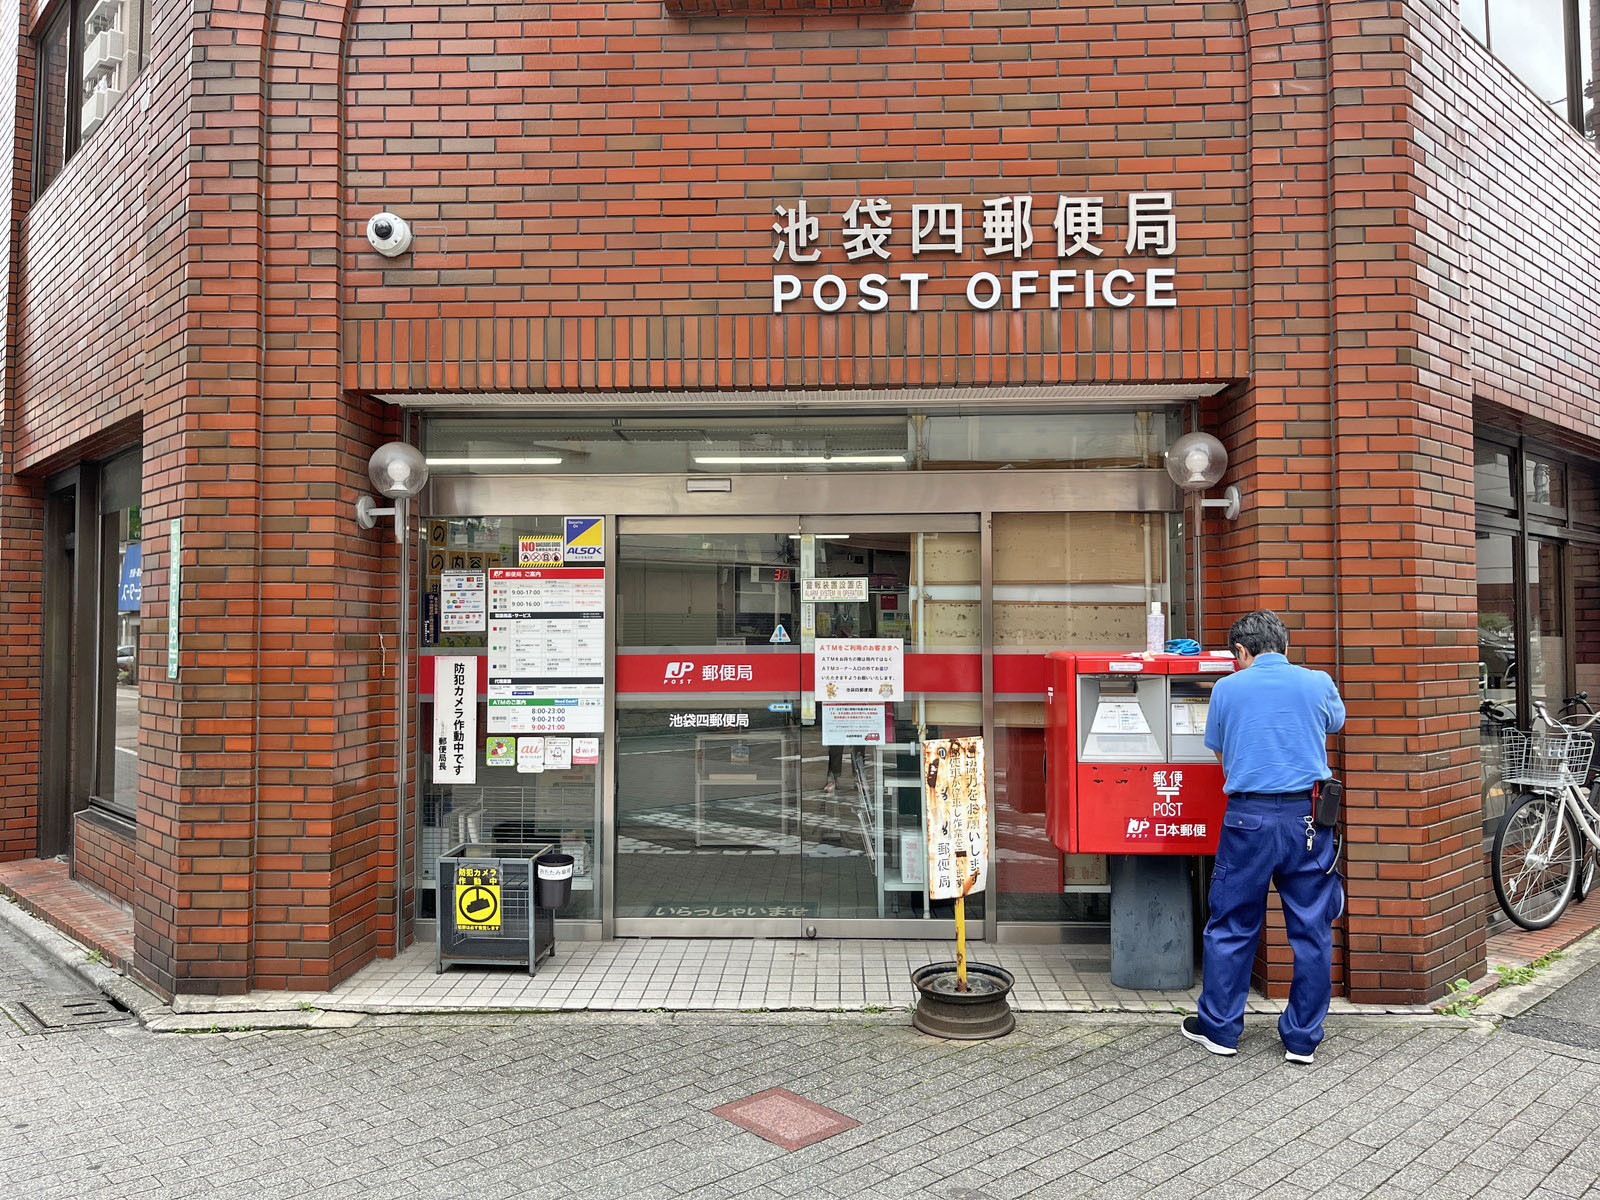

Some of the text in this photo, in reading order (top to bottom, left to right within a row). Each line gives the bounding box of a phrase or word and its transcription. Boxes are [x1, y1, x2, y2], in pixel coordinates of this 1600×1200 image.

[772, 192, 1178, 263] 池袋四郵便局
[773, 268, 1178, 314] POST OFFICE
[521, 541, 536, 552] NO
[566, 546, 603, 555] ALSOK
[701, 664, 753, 682] 郵便局
[531, 707, 566, 715] 8:00-23:00
[453, 662, 466, 776] 防犯カメラ作動中です
[669, 713, 750, 728] 池袋四郵便局
[520, 744, 541, 754] au
[1152, 770, 1184, 788] 郵便
[1152, 802, 1184, 817] POST
[1155, 823, 1207, 837] 日本郵便
[458, 868, 498, 877] 防犯カメラ
[655, 905, 809, 917] いらっしゃいませ
